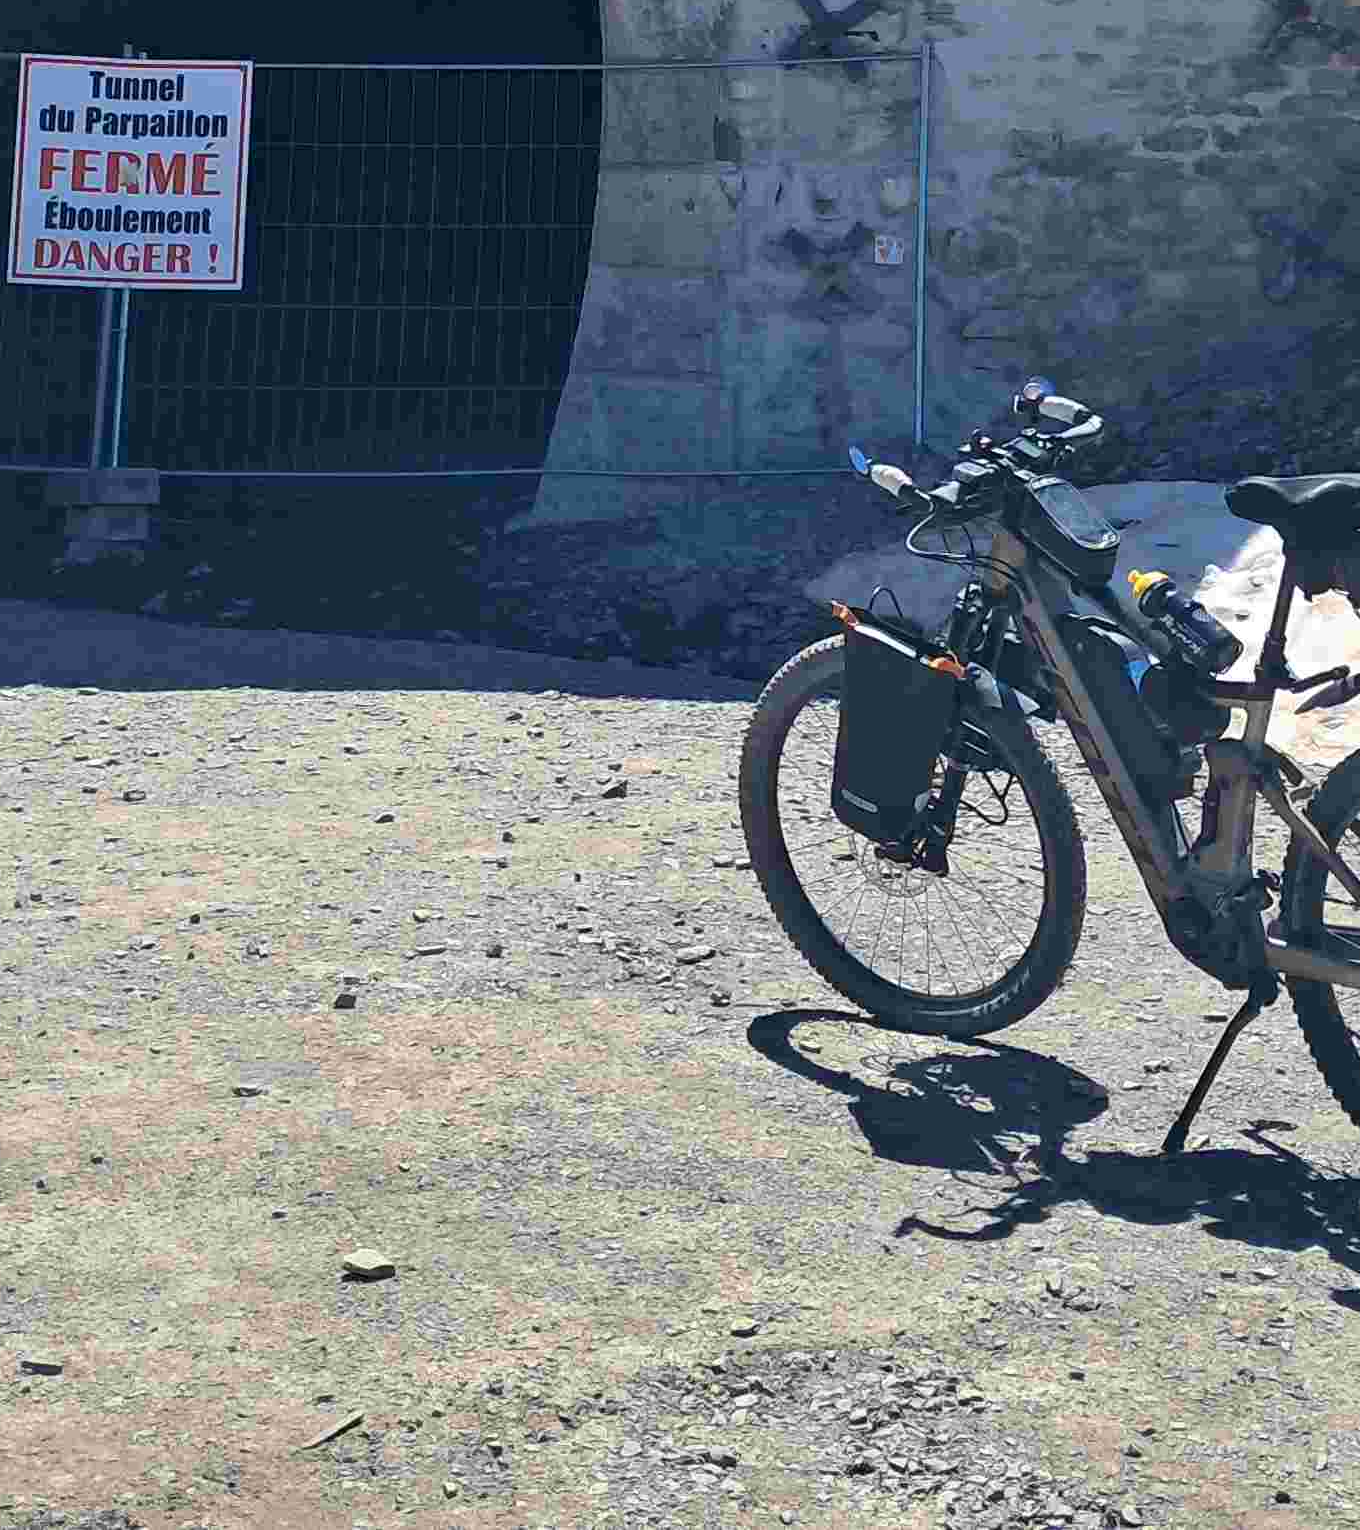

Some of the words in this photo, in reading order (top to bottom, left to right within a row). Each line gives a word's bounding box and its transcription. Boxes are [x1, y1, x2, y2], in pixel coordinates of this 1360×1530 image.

[88, 70, 185, 102] Tunnel
[39, 104, 75, 133] du
[84, 105, 229, 140] Parpaillon
[38, 141, 223, 197] FERMÉ
[43, 195, 213, 234] Éboulement
[32, 238, 192, 274] DANGER
[207, 243, 220, 275] !
